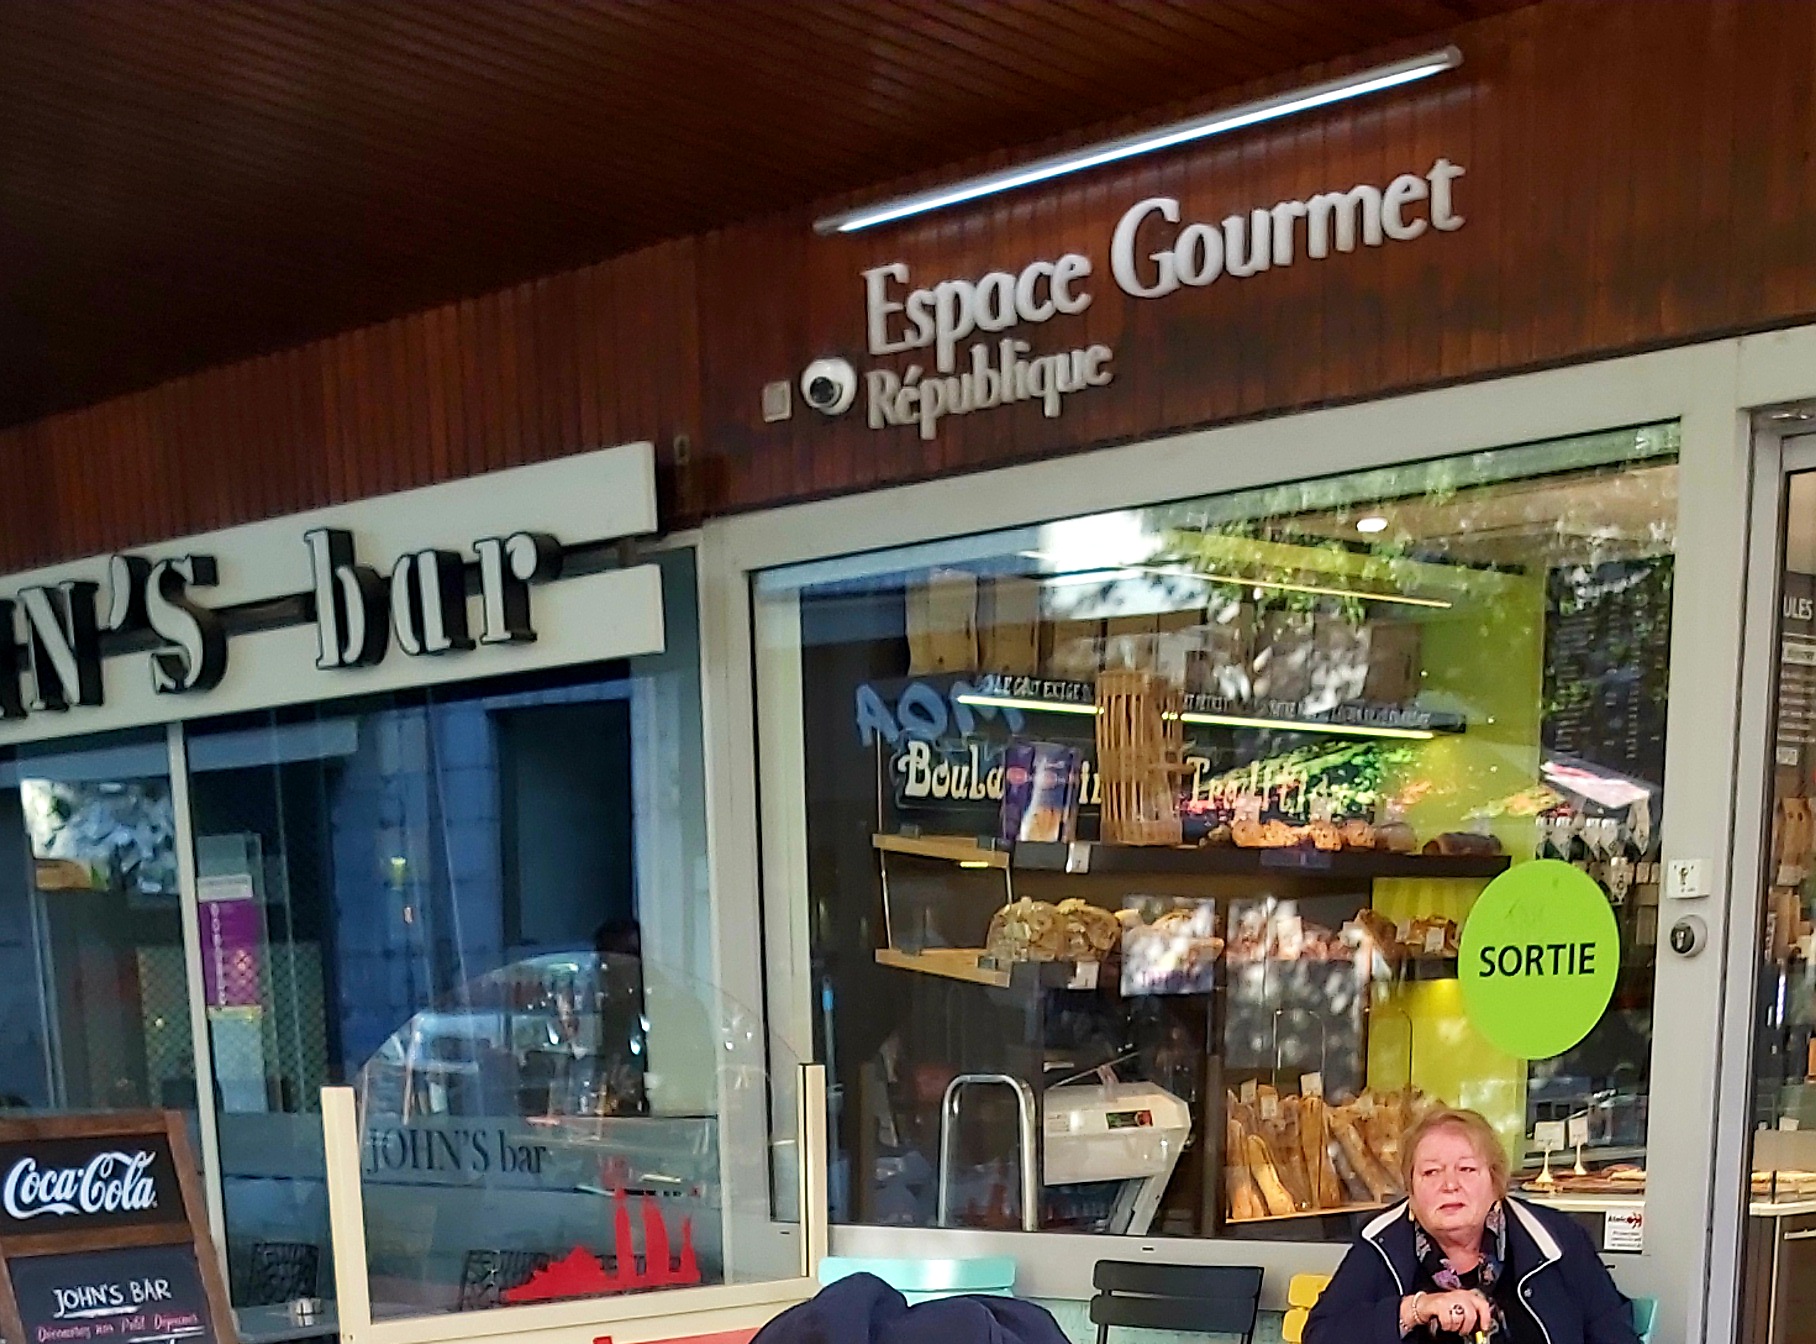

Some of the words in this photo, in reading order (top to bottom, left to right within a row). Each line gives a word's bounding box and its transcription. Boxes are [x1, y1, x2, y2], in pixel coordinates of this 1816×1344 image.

[861, 252, 1093, 373] Espace
[1110, 157, 1467, 299] Gourmet
[864, 338, 1114, 440] République
[0, 554, 228, 720] N'S
[304, 528, 562, 670] bar
[1783, 595, 1813, 641] ULES
[1479, 942, 1596, 977] SORTIE
[366, 1128, 491, 1175] JOHN'S
[498, 1129, 547, 1174] bar
[4, 1150, 157, 1220] Coca-Cola
[53, 1284, 124, 1318] JOHN'S
[130, 1279, 172, 1303] BAR
